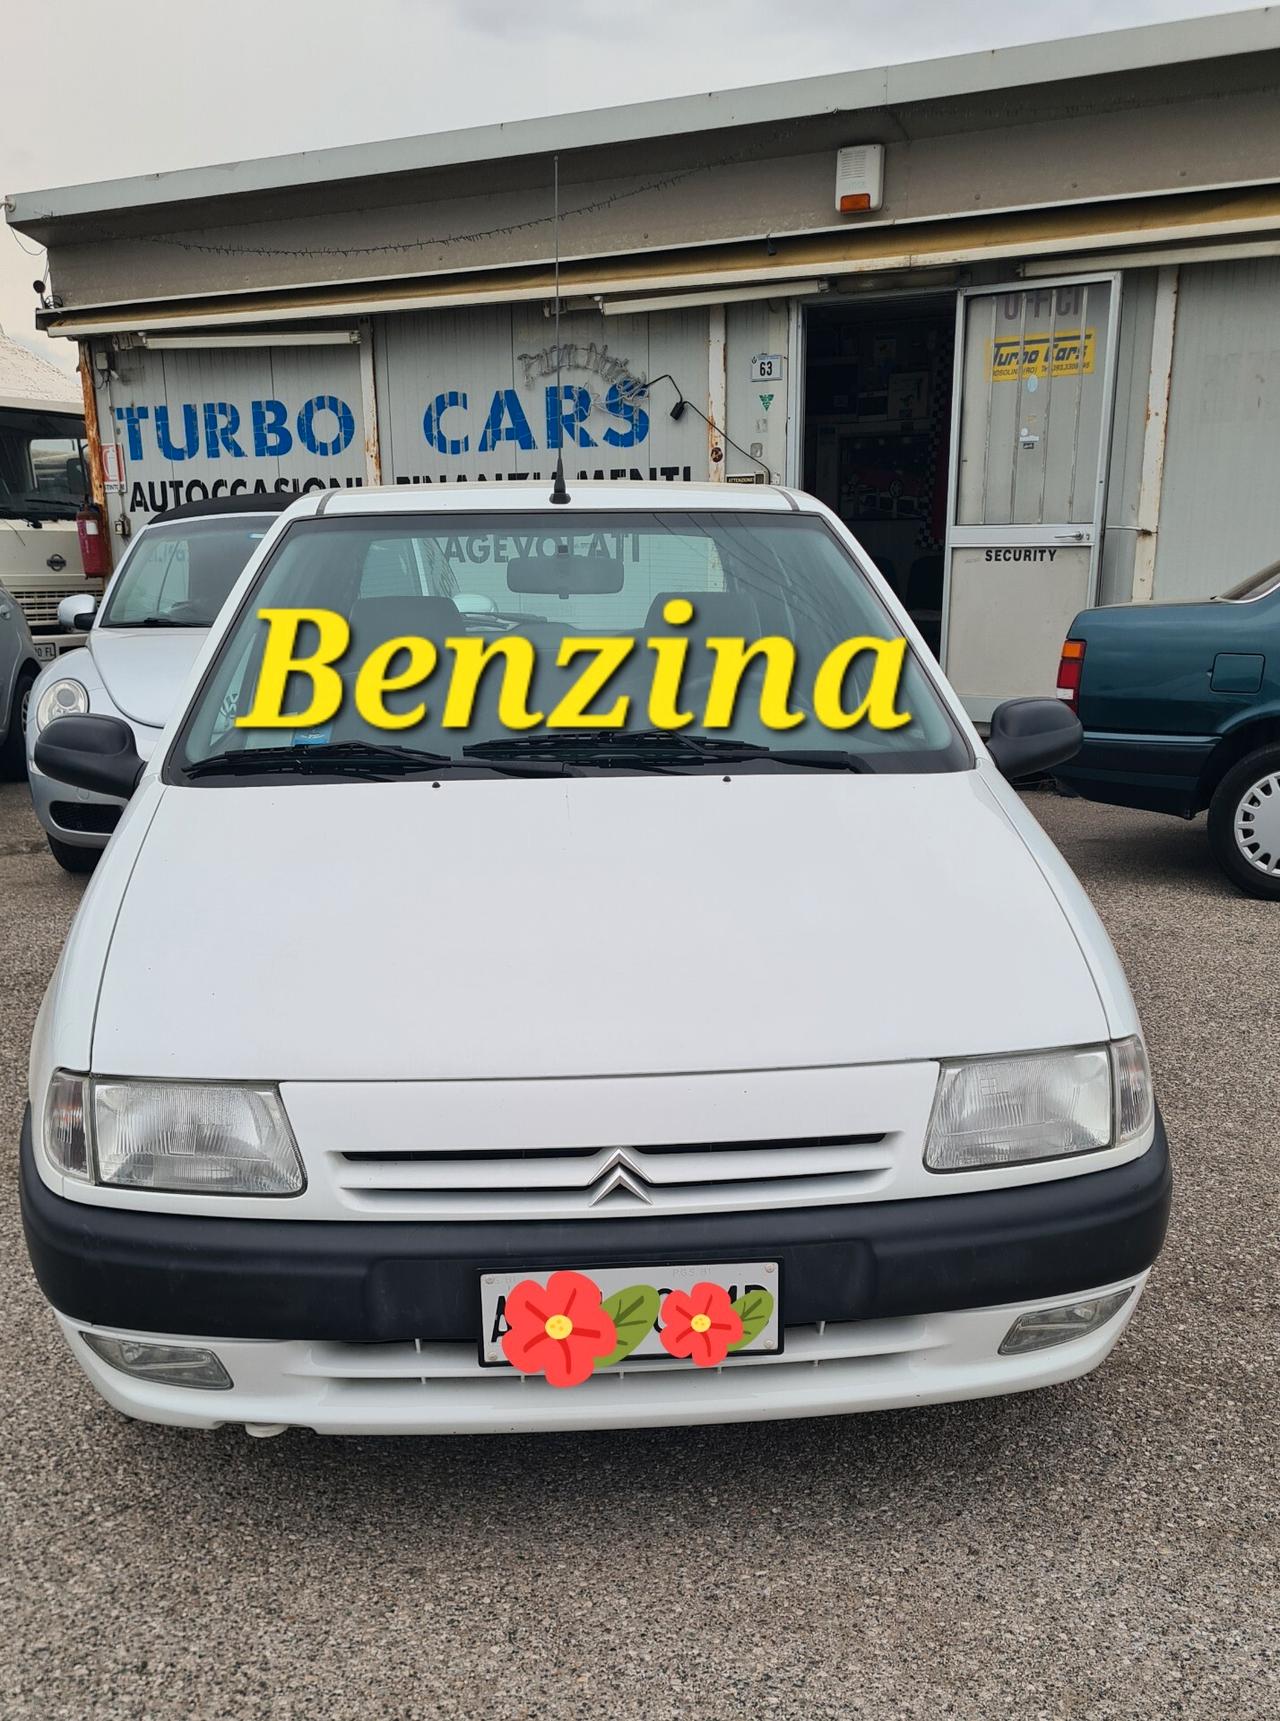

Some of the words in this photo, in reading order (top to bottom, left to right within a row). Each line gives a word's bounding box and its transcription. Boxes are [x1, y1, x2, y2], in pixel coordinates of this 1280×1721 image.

[760, 361, 773, 376] 63
[116, 395, 355, 461] TURBO
[423, 381, 649, 455] CARS
[130, 477, 363, 513] AUTOCCASIO
[985, 549, 1057, 562] SECURITY
